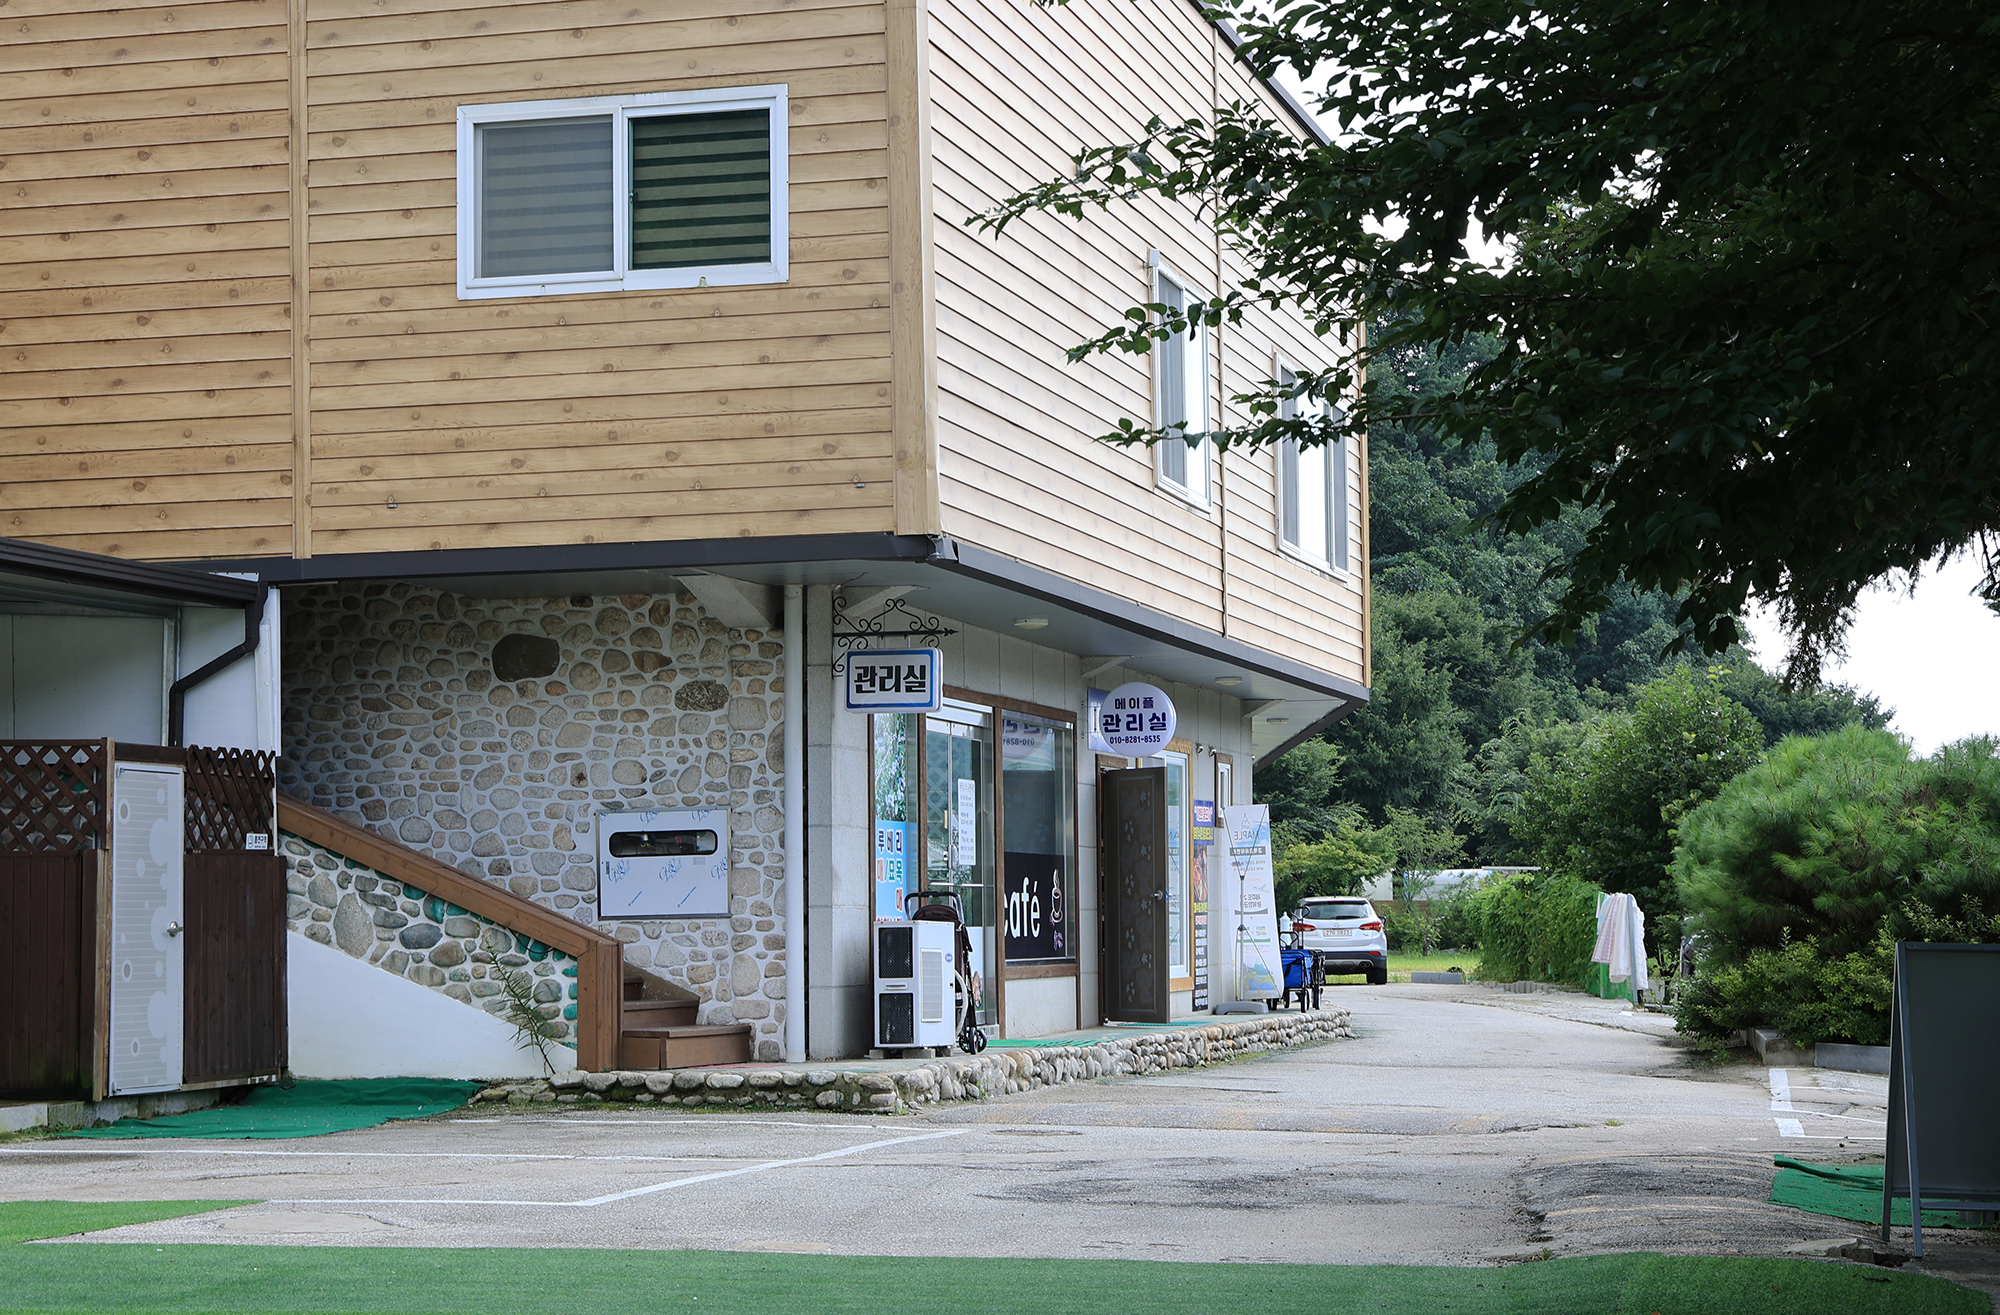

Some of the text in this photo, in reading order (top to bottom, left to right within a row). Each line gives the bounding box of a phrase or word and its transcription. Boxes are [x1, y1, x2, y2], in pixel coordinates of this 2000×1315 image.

[854, 665, 926, 693] 관리실
[1114, 697, 1154, 710] 메이플
[1102, 712, 1166, 732] 관리실
[1110, 735, 1160, 744] 010-8281-8535
